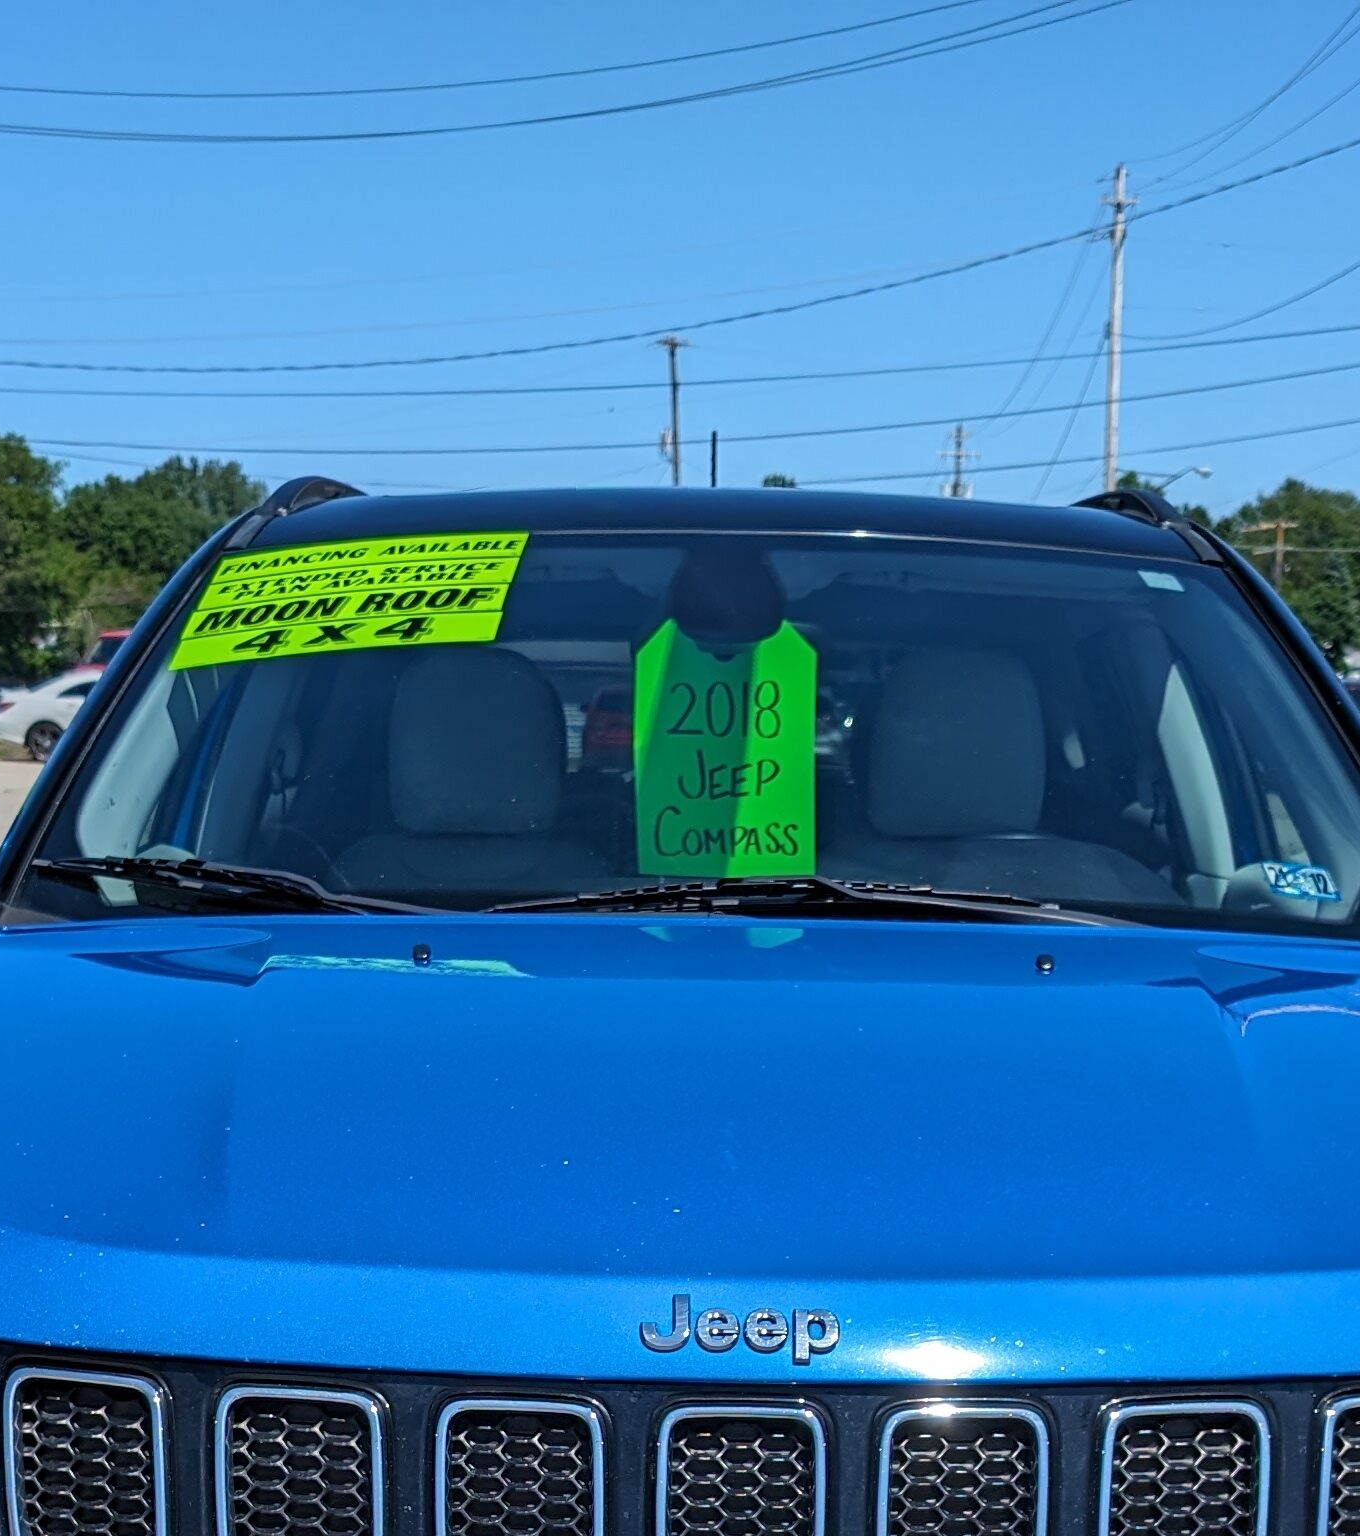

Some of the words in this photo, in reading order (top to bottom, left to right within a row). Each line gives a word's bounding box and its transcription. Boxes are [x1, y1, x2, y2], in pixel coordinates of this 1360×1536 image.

[217, 569, 369, 595] EXTENDED
[381, 561, 505, 576] SERVICE
[219, 547, 370, 577] FINANCING
[378, 539, 523, 557] AVAILABLE
[232, 583, 311, 600] PLAN
[320, 571, 480, 590] AVAILABLE
[193, 595, 353, 635] MOON
[355, 587, 501, 616] ROOF
[232, 629, 291, 656] 4
[375, 615, 437, 642] 4
[666, 680, 782, 739] 2018
[677, 749, 781, 800] JEEP
[1309, 872, 1334, 896] 12
[640, 1293, 841, 1366] Jeep
